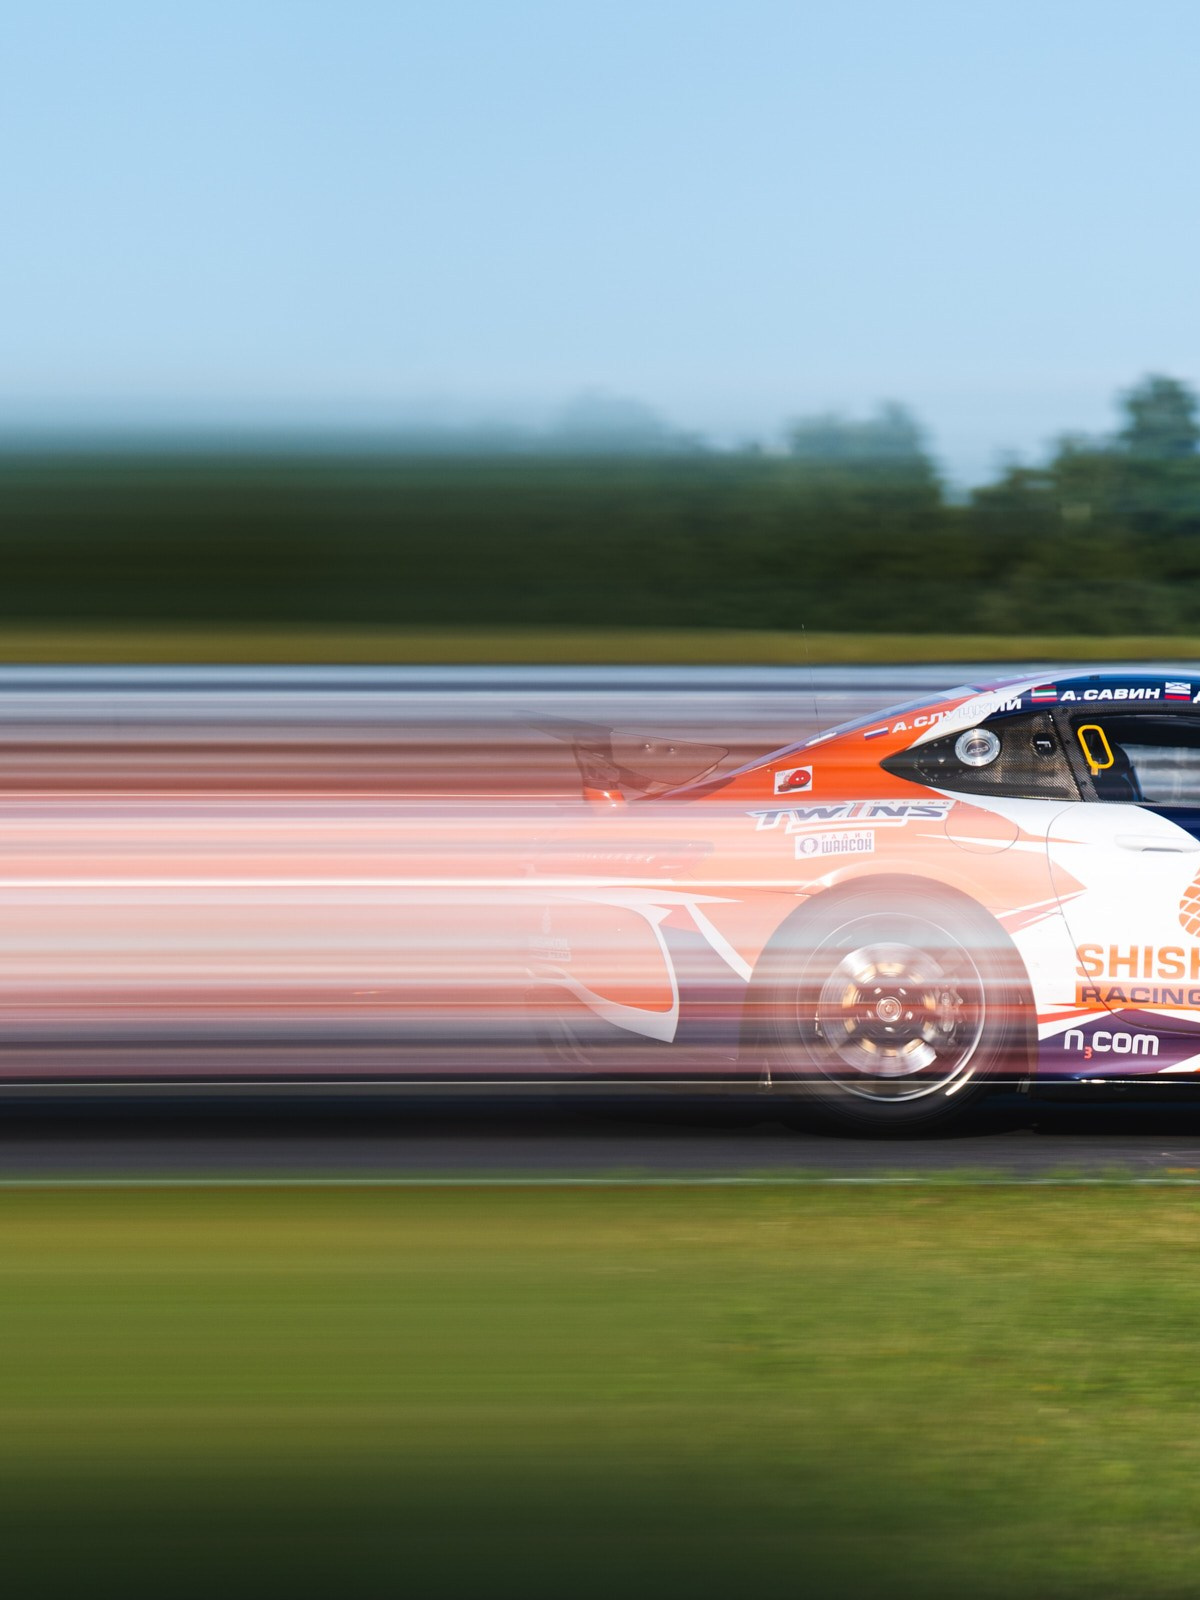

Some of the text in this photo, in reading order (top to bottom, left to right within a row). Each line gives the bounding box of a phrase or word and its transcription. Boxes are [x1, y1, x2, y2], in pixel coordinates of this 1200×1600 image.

[1060, 688, 1161, 702] А.САВИН
[747, 801, 951, 829] TWINS
[821, 832, 872, 840] РАДИО
[821, 838, 872, 854] ШАНСОН
